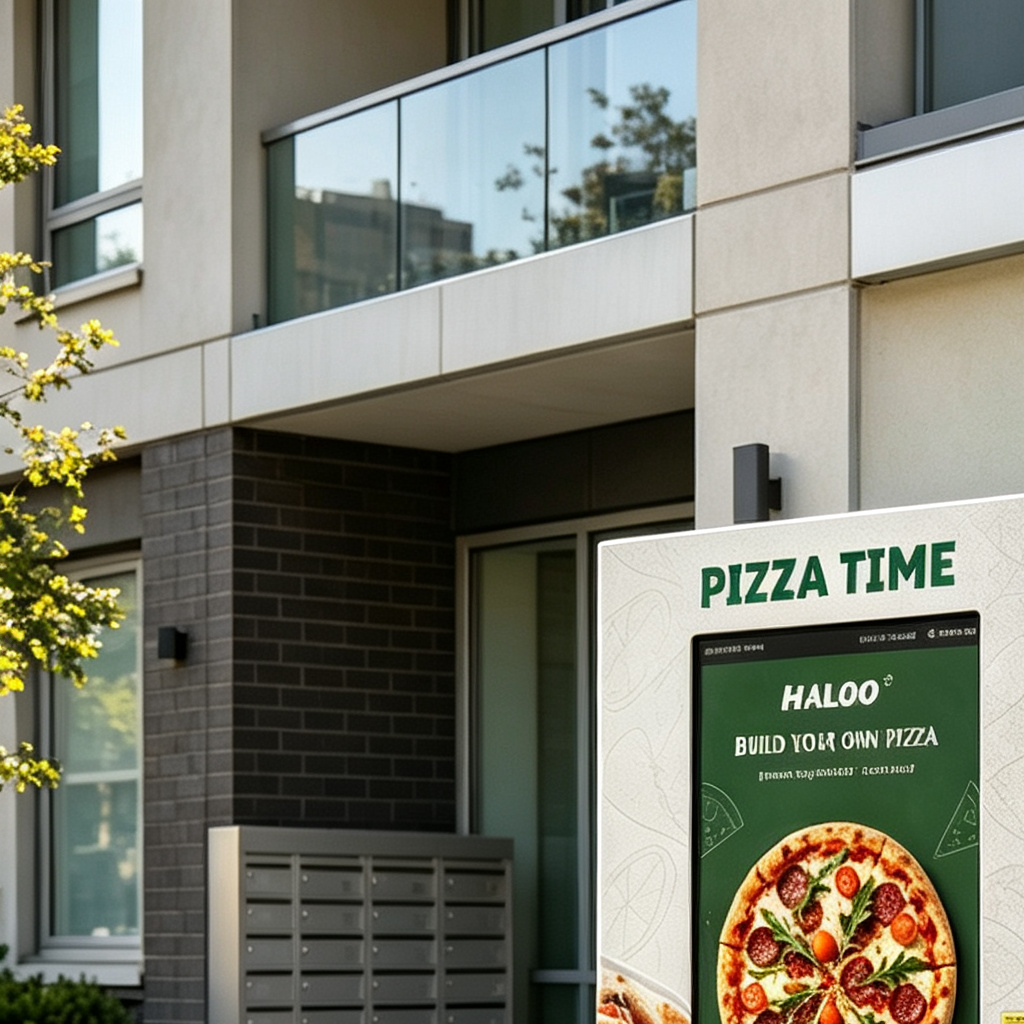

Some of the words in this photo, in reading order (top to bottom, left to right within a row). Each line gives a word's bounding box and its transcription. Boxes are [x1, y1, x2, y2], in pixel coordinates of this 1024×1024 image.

[700, 555, 829, 609] PIZZA
[839, 540, 956, 595] TIME
[780, 679, 880, 711] HALOO
[734, 733, 786, 757] BUILD
[886, 725, 939, 748] PIZZA
